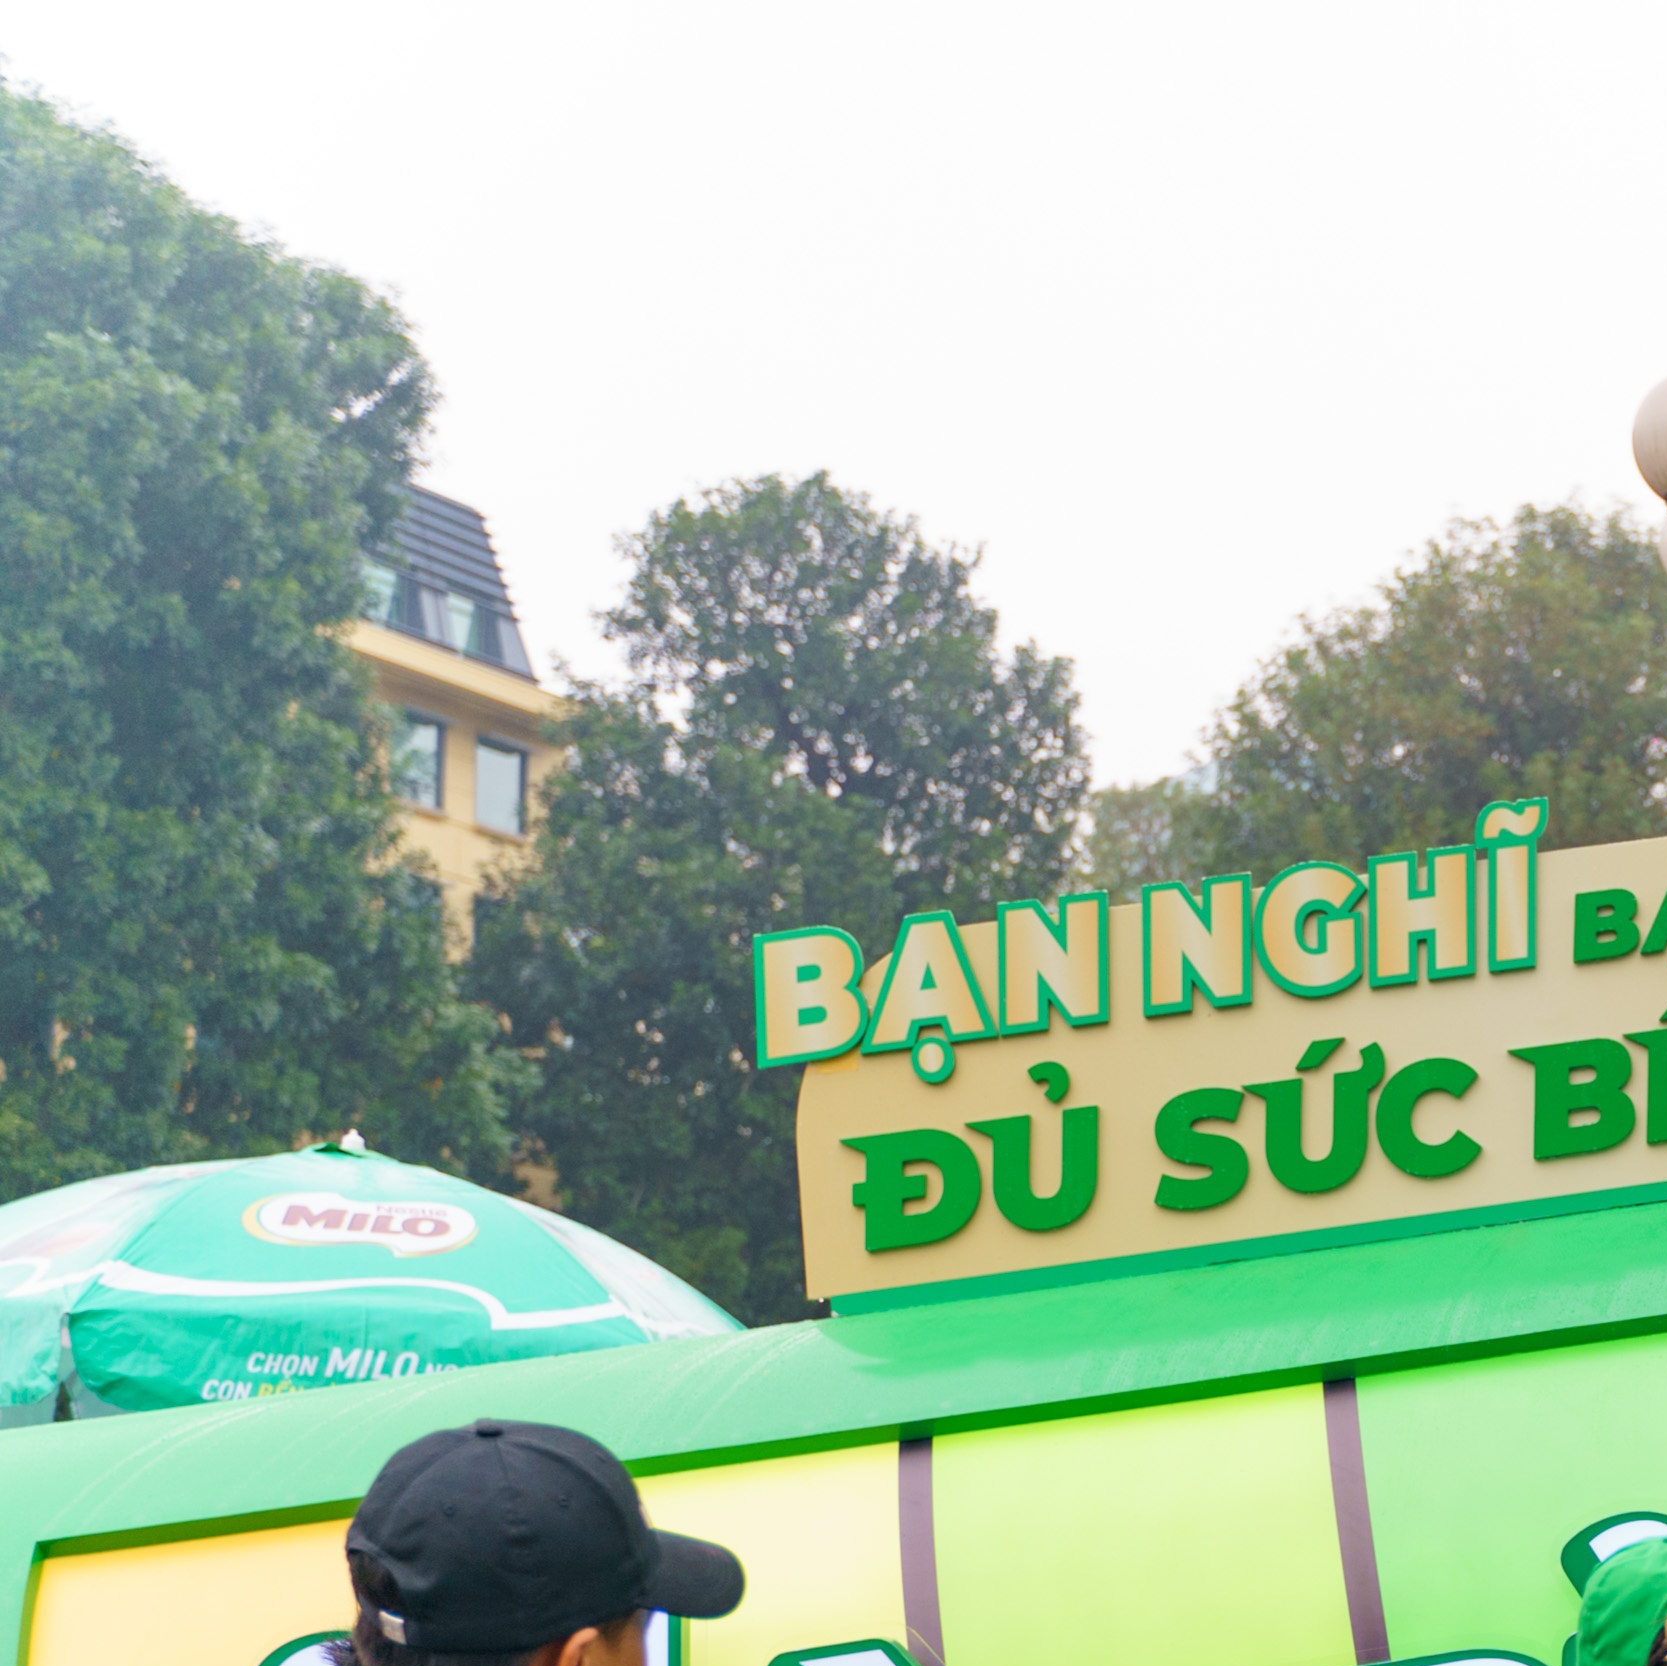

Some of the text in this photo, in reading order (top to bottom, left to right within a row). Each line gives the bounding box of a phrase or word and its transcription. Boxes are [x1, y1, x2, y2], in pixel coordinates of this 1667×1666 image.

[755, 889, 1110, 1084] BẠN
[1141, 797, 1549, 1019] NGHĨ
[840, 1061, 1101, 1253] ĐỦ
[1153, 1037, 1483, 1210] SỨC
[281, 1204, 451, 1238] MILO
[246, 1346, 420, 1381] CHỌN MILO
[201, 1378, 253, 1401] CON
